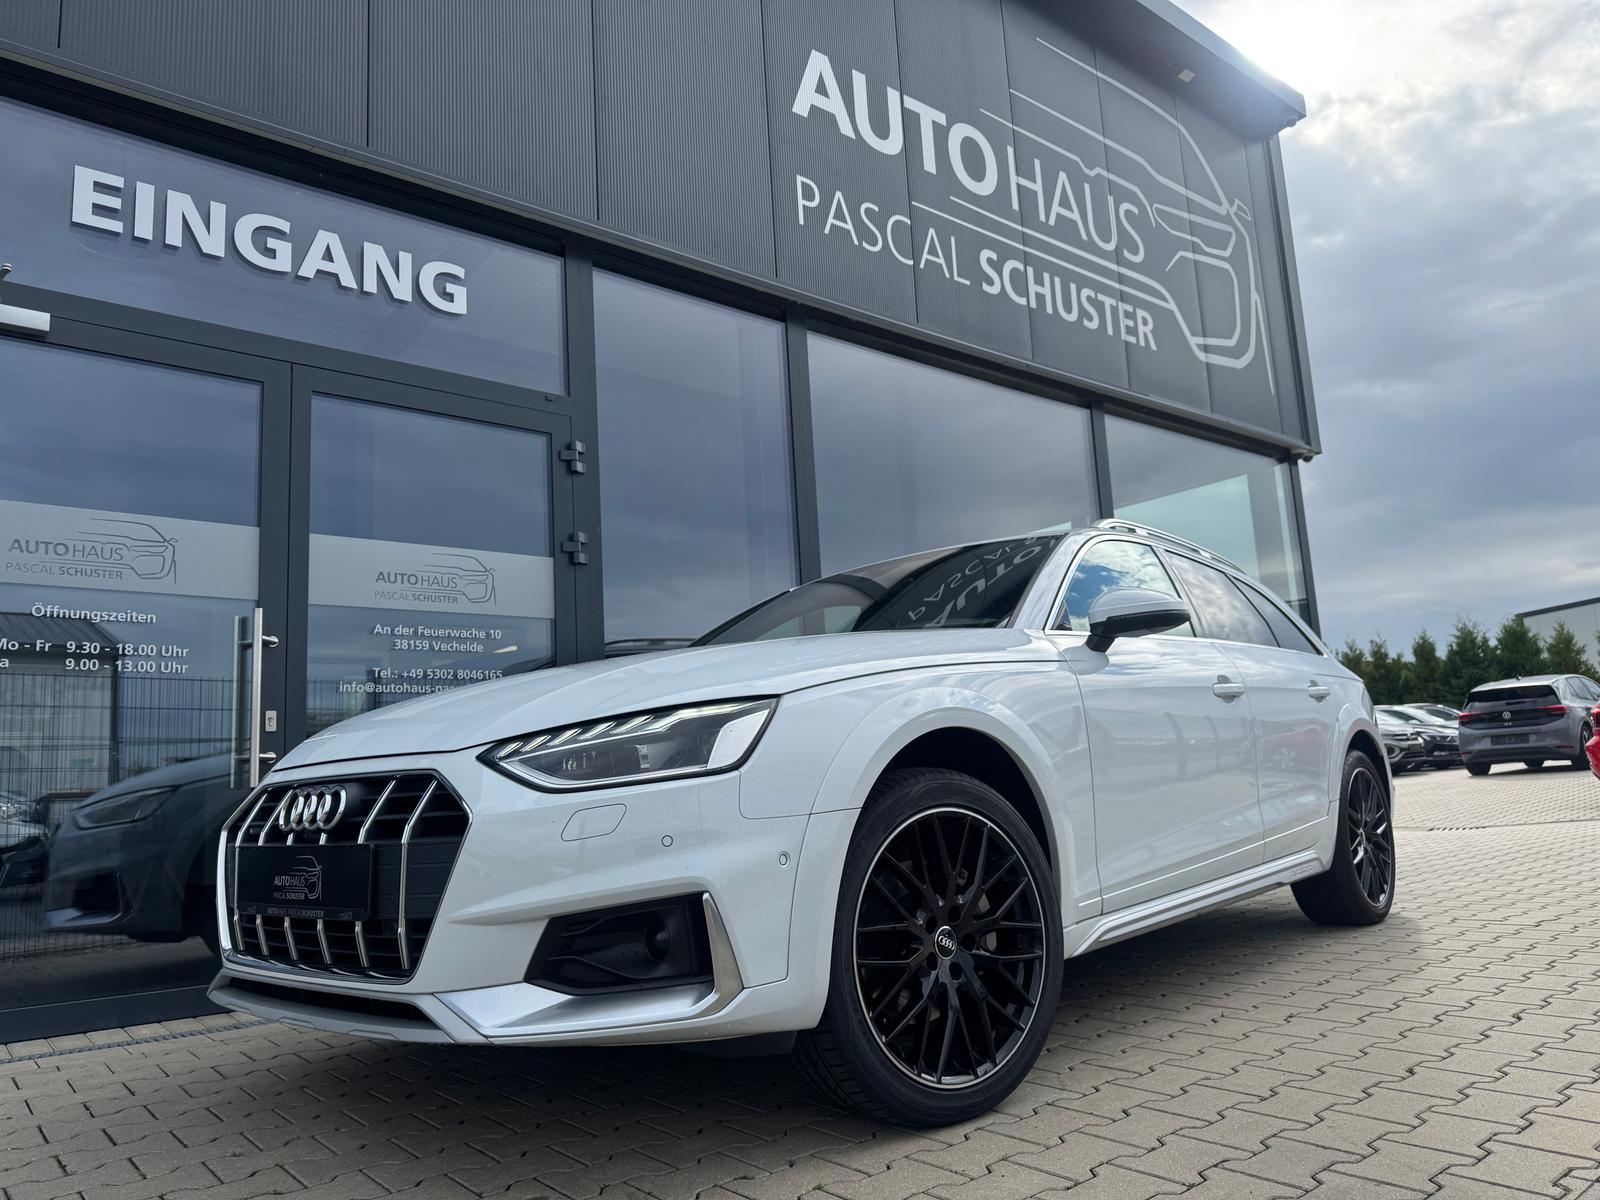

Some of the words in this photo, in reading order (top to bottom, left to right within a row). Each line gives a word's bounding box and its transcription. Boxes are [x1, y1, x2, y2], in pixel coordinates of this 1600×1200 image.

[71, 164, 468, 316] EINGANG
[795, 174, 971, 286] PASCAL
[978, 248, 1158, 352] SCHUSTER
[6, 561, 55, 576] PASCAL
[58, 565, 124, 581] SCHUSTER
[374, 590, 410, 602] PASCAL
[411, 592, 458, 605] SCHUSTER
[31, 601, 157, 624] Öffnungszeiten
[373, 624, 391, 635] An
[394, 624, 414, 636] der
[418, 625, 486, 639] Feuerwache
[488, 629, 502, 640] 10
[35, 639, 53, 652] Fr
[66, 641, 100, 655] 9.30
[116, 643, 157, 657] 18.00
[161, 645, 190, 658] Uhr
[394, 639, 430, 651] 38159
[432, 640, 484, 653] Vechelde
[65, 658, 99, 671] 9.00
[115, 659, 156, 673] 13.00
[160, 661, 189, 674] Uhr
[372, 667, 398, 679] Tel.:
[401, 668, 424, 680] +49
[426, 668, 454, 680] 5302
[457, 669, 503, 680] 8046165
